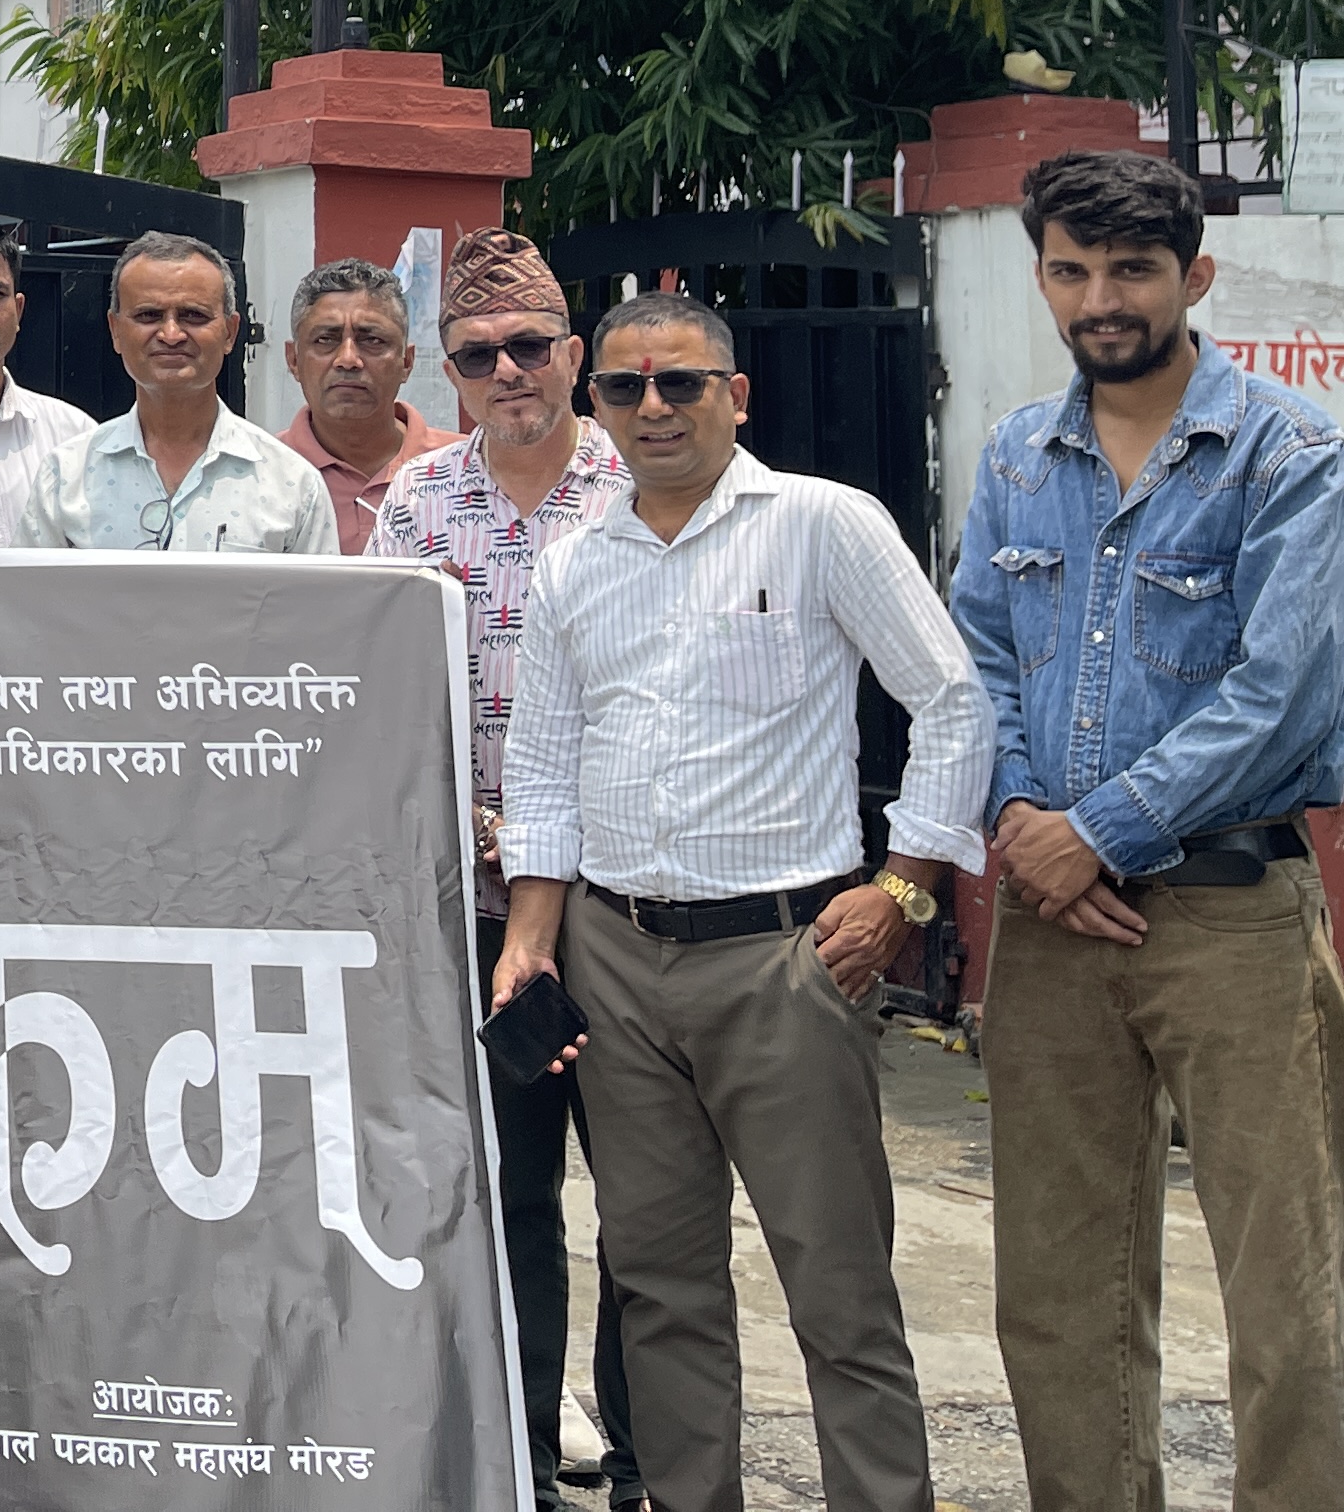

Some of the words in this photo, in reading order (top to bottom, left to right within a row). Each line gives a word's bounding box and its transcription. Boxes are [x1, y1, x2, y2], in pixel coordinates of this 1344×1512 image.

[60, 677, 137, 711] तथा
[157, 663, 360, 713] अभिव्यक्ति
[52, 1434, 160, 1476] पत्रकार
[173, 1438, 275, 1480] महासंघ
[287, 1437, 375, 1482] मोरङ
